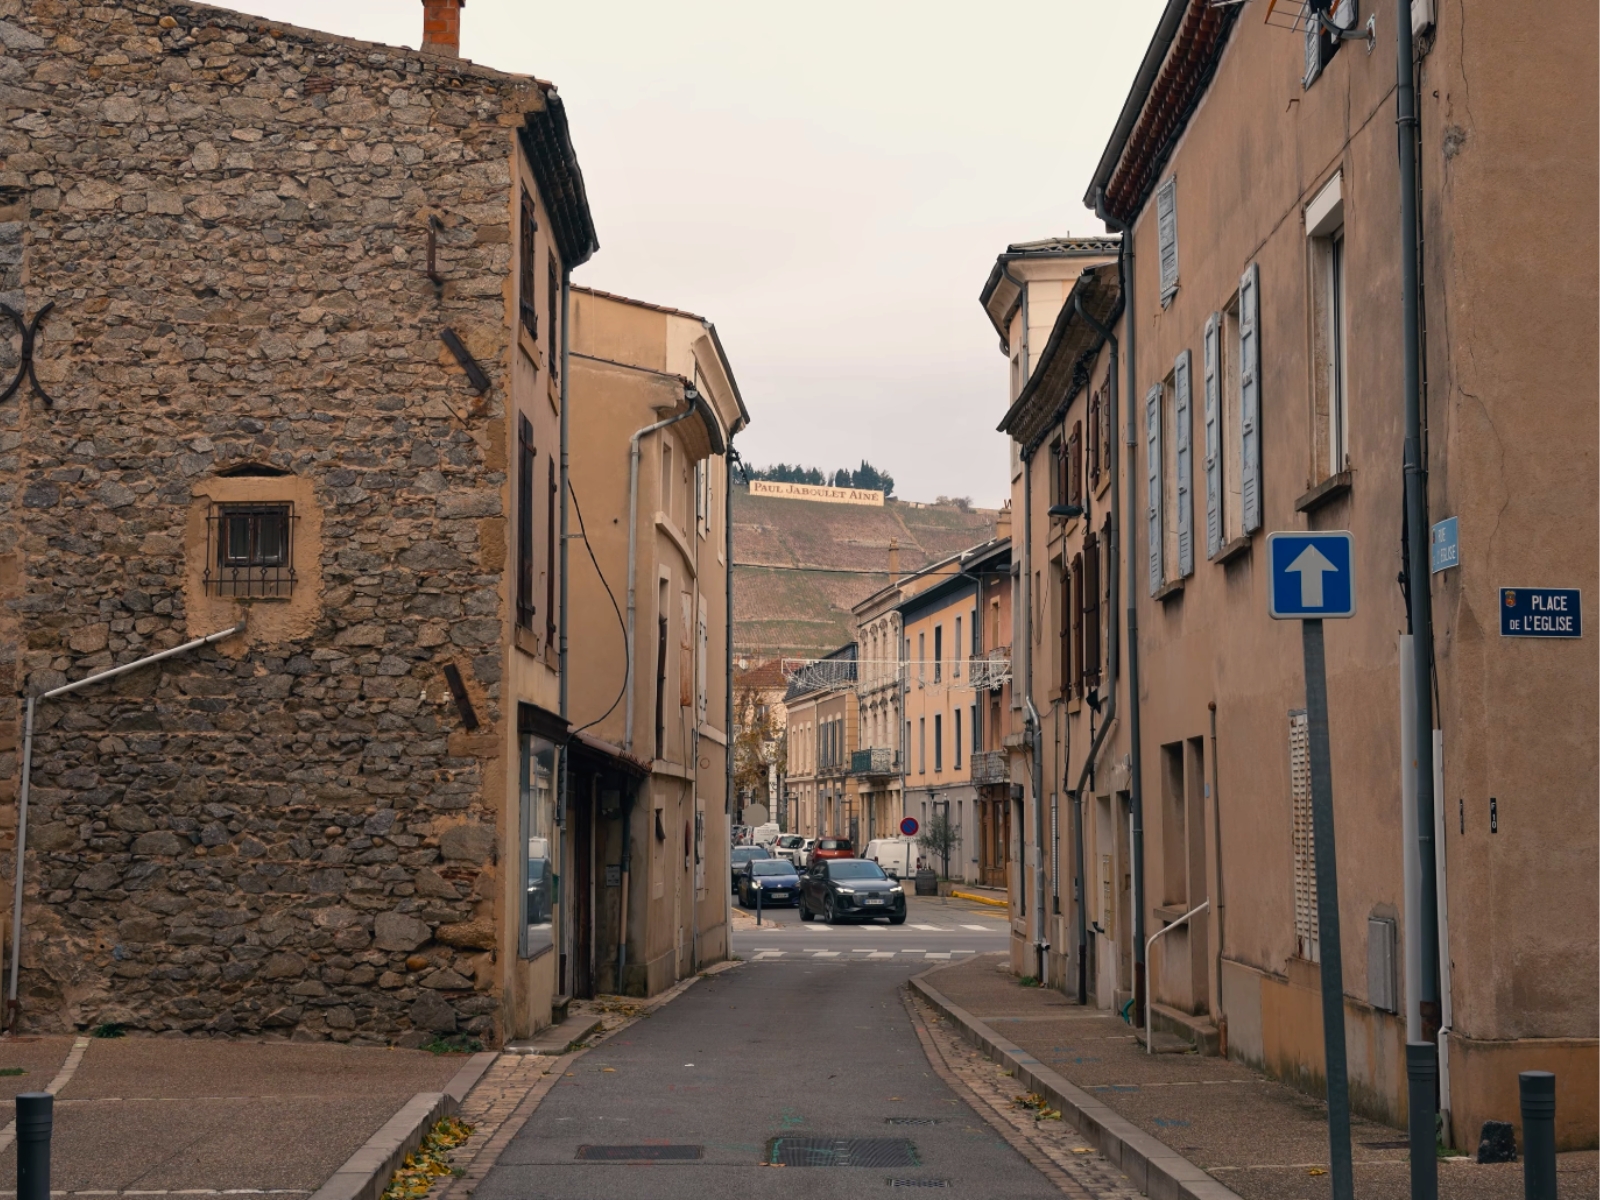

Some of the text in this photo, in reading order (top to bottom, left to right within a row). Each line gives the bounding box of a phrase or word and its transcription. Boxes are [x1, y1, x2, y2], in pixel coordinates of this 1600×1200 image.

[754, 482, 784, 493] PAUL
[786, 485, 846, 498] JABOULET
[1531, 595, 1568, 611] PLACE
[1509, 615, 1573, 631] DE L'EGLISE
